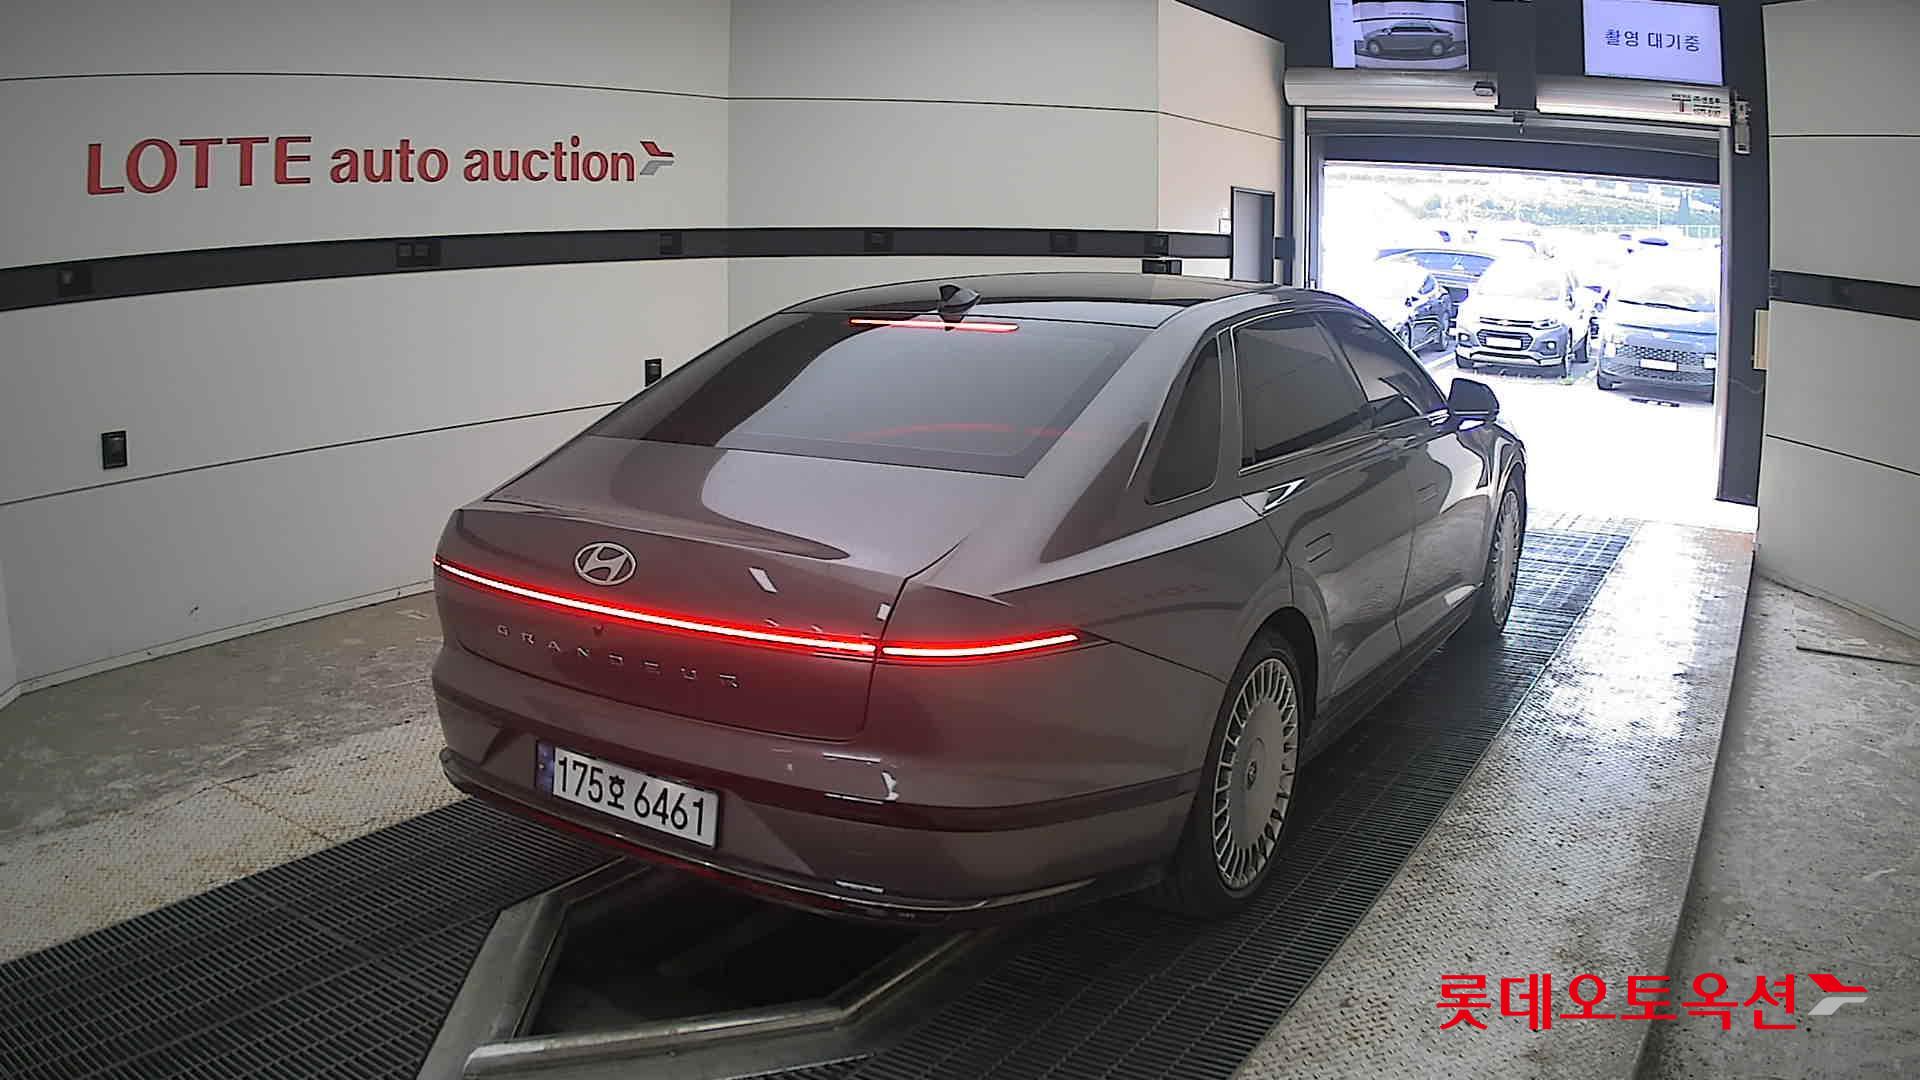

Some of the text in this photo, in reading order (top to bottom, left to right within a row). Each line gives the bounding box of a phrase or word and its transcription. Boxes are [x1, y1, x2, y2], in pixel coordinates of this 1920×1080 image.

[1647, 32, 1700, 52] 대기중
[87, 135, 636, 195] LOTTE auto auction
[497, 623, 740, 689] GRANDEUR
[558, 756, 704, 836] 175호 6461
